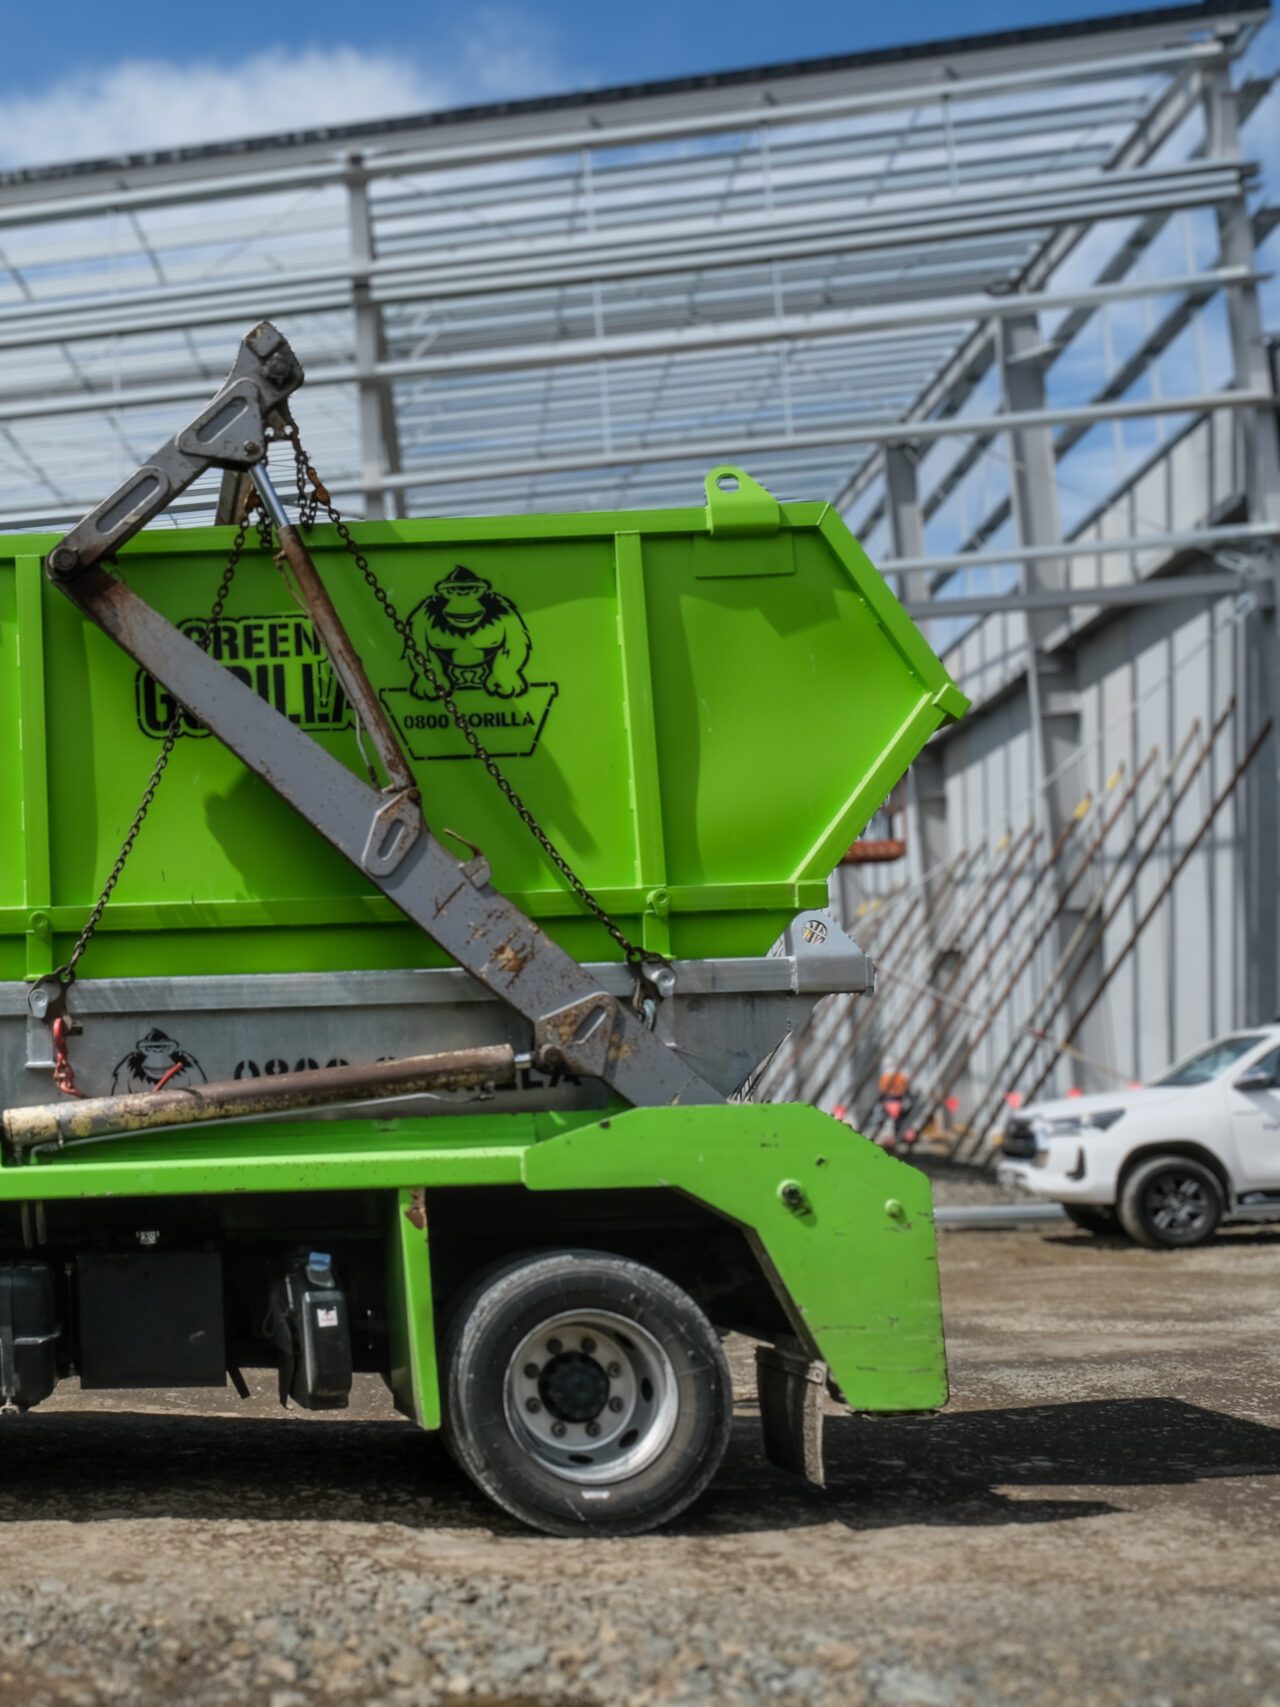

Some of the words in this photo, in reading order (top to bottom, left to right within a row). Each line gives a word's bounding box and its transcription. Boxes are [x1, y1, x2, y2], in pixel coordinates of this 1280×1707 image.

[144, 663, 354, 732] GILL
[404, 714, 449, 729] 0800
[456, 712, 535, 728] ORILLA
